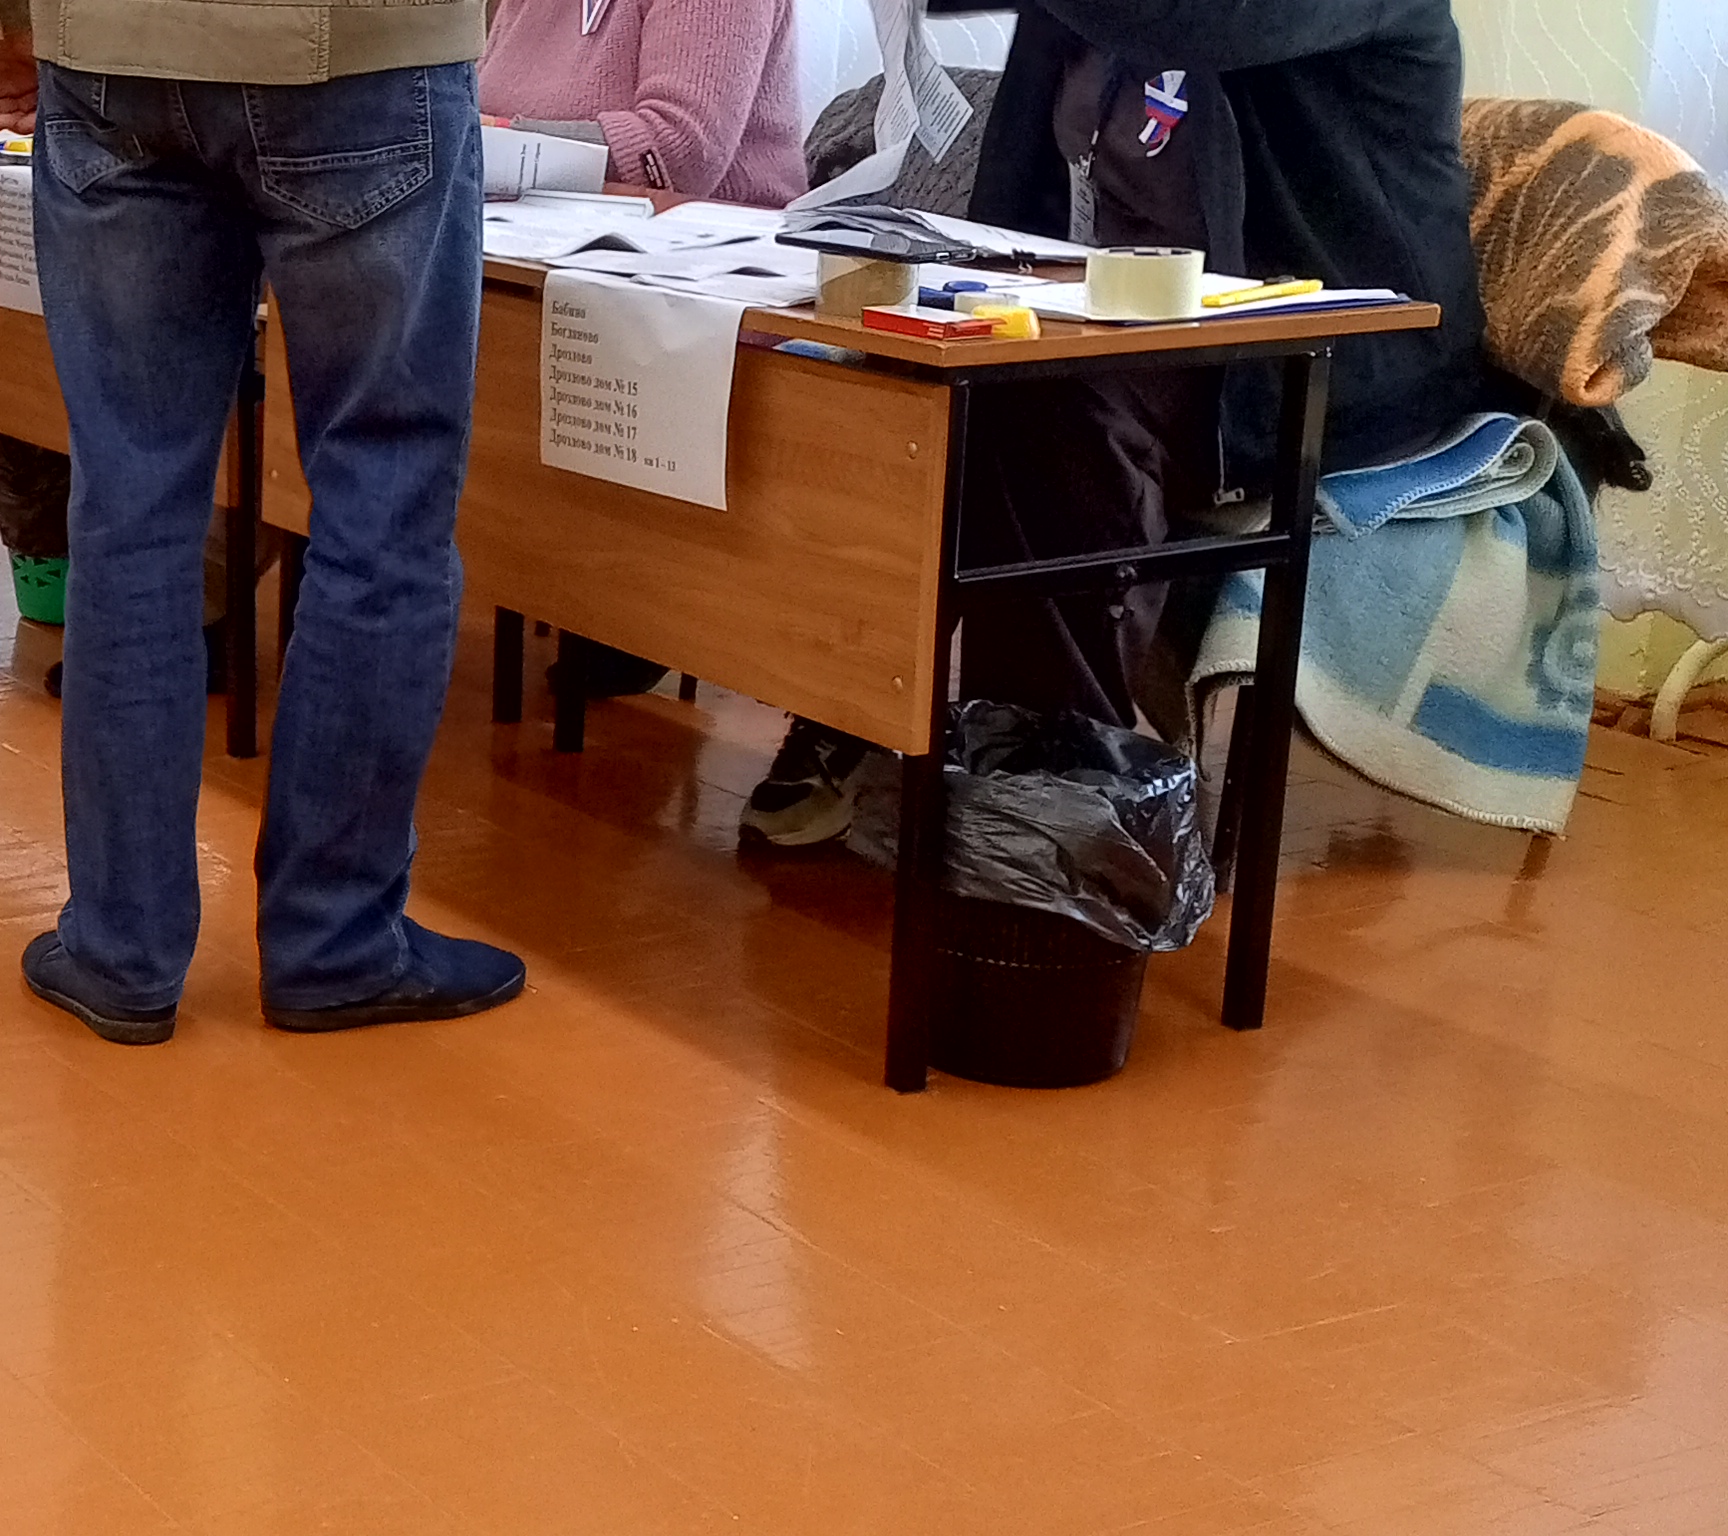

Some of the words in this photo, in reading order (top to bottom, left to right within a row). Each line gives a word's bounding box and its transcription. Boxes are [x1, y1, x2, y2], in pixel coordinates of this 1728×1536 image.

[627, 381, 638, 396] 15
[626, 403, 638, 419] 16
[626, 425, 637, 440] 17
[626, 447, 637, 463] 18
